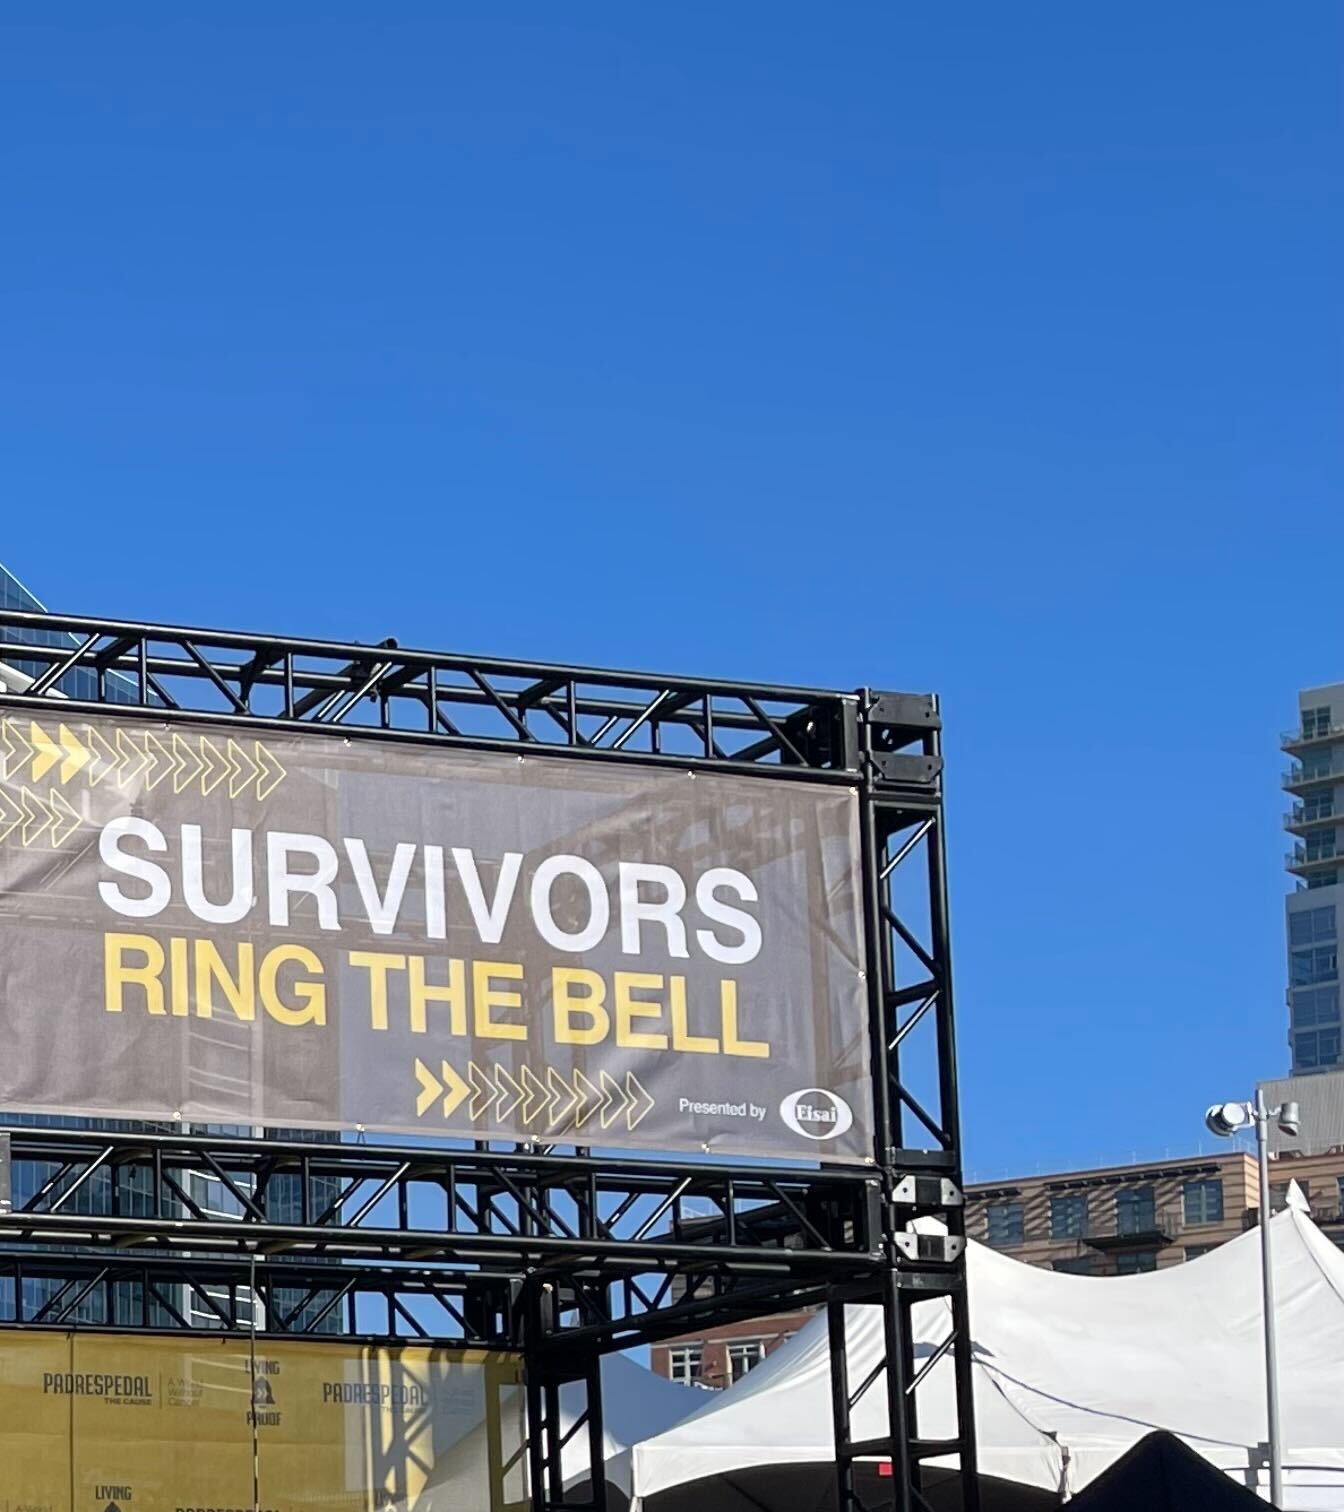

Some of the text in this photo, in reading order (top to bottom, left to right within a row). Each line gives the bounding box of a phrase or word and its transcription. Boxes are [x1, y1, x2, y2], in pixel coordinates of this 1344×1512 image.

[98, 816, 763, 965] SURVIVORS
[104, 932, 770, 1058] RING THE BELL
[679, 1098, 766, 1121] Presented by
[796, 1104, 838, 1123] Eisai
[245, 1359, 280, 1375] LVING
[43, 1373, 152, 1397] PADRESPEDAL
[323, 1382, 427, 1406] PADRESPEDAL
[105, 1397, 121, 1405] THE
[96, 1485, 132, 1500] LIVING
